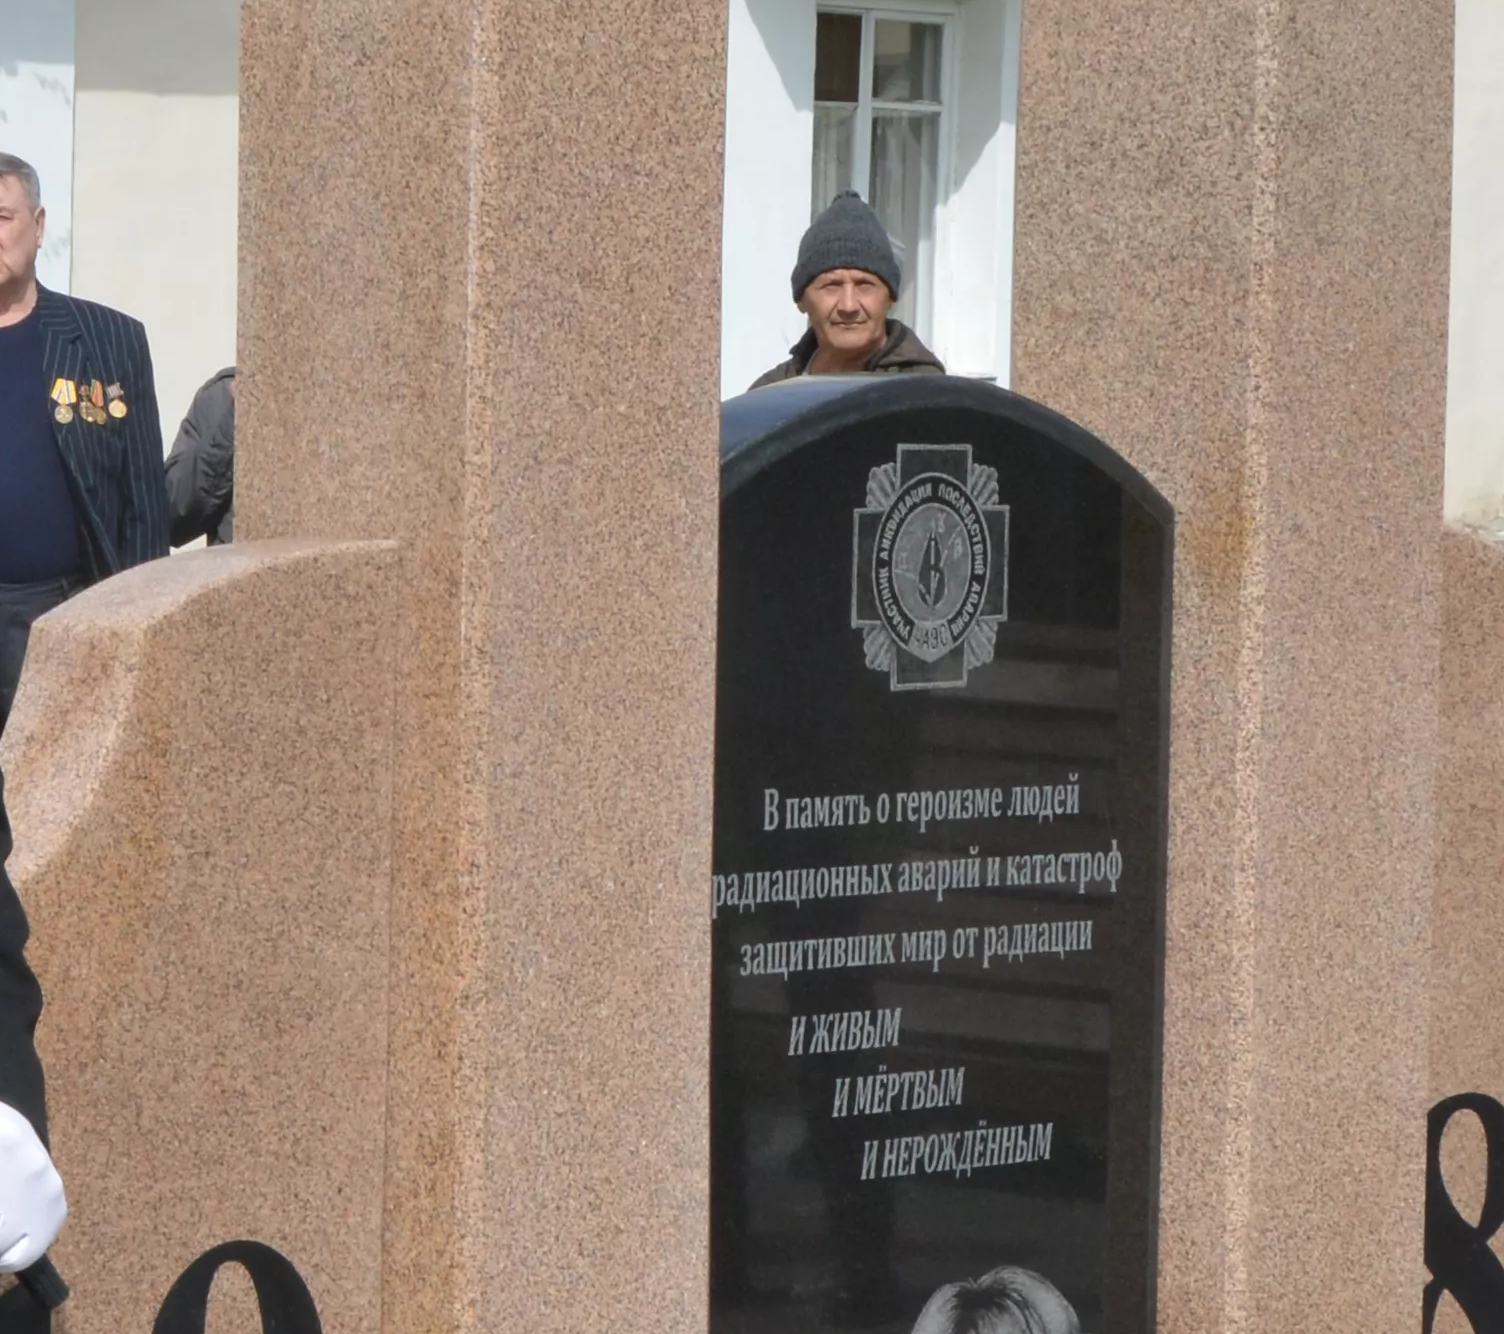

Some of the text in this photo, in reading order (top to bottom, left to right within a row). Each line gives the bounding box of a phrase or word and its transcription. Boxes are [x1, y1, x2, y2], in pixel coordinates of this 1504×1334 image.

[763, 772, 1080, 833] В память о героизме людей
[712, 839, 1123, 919] радиационных аварий и катастроф
[740, 920, 1093, 981] защитивших мир от радиации
[787, 1007, 902, 1056] И ЖИВЫМ
[832, 1065, 965, 1117] И МЁРТВЫМ
[860, 1120, 1053, 1180] И НЕРОЖДЁННЫМ
